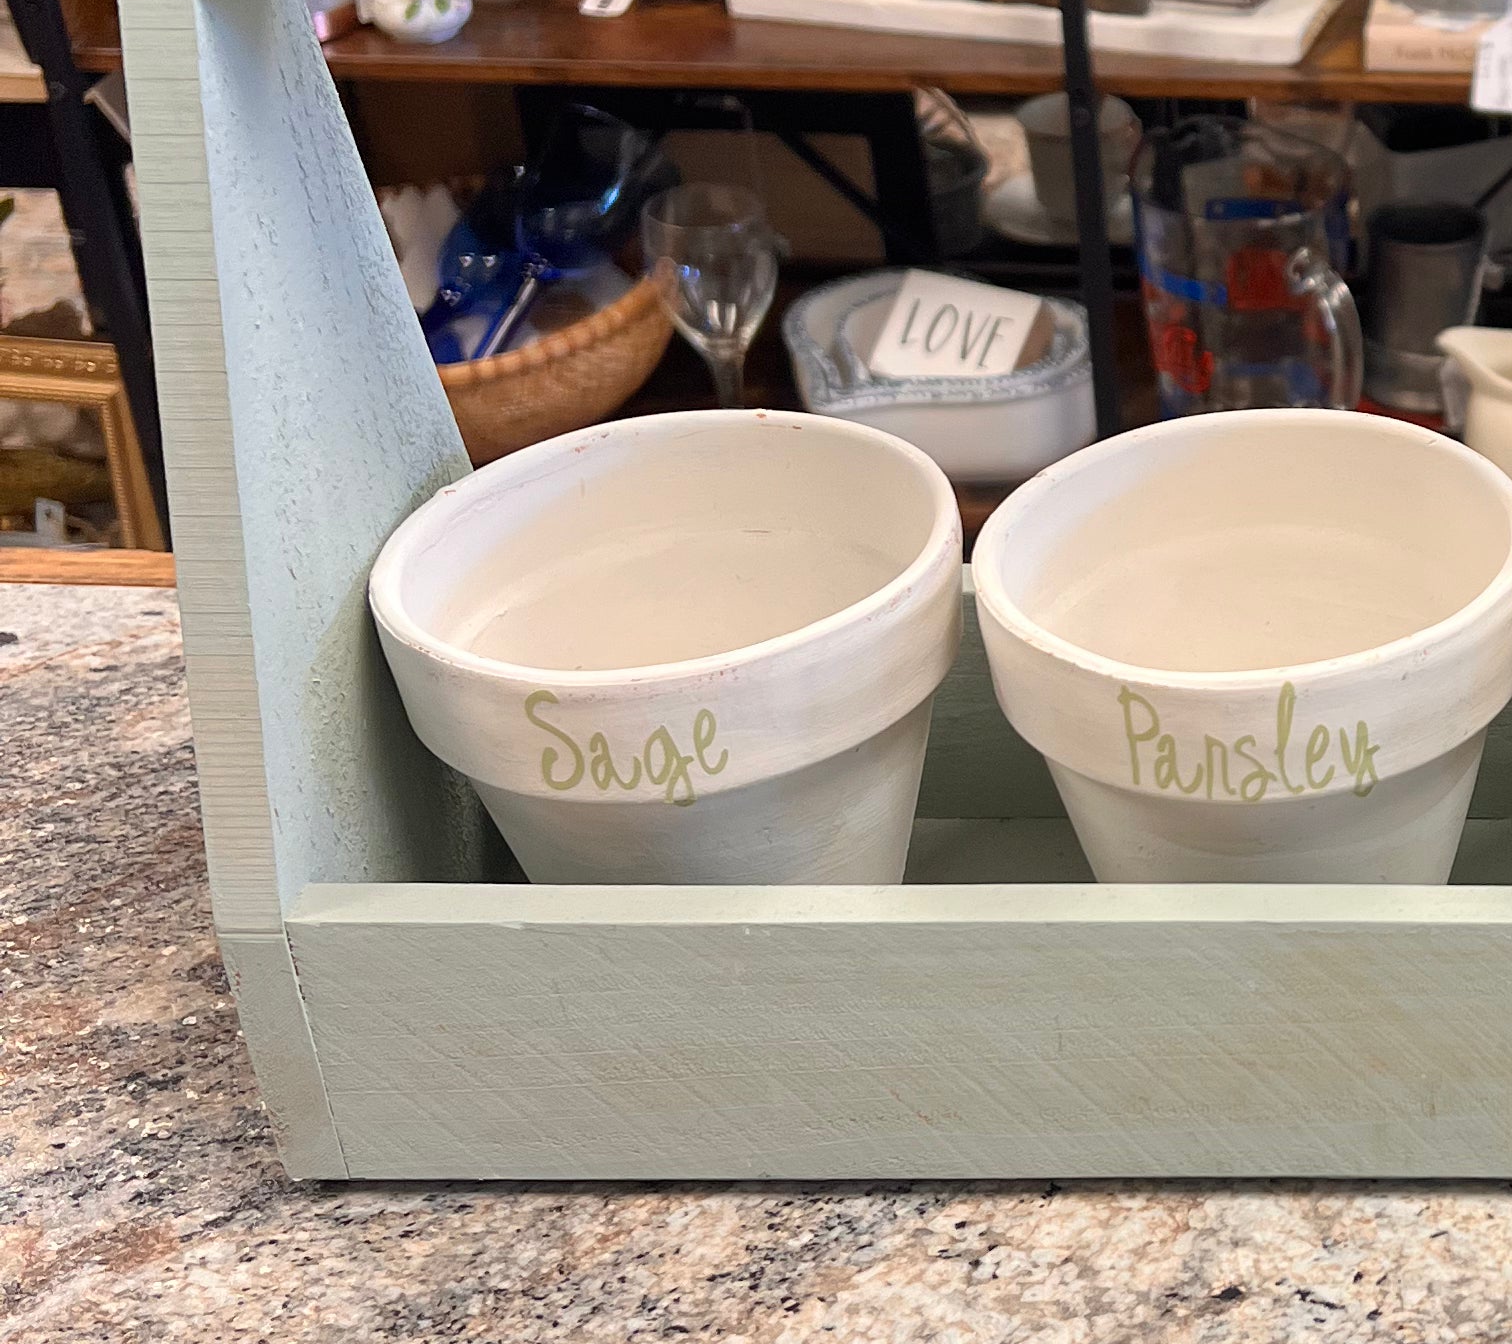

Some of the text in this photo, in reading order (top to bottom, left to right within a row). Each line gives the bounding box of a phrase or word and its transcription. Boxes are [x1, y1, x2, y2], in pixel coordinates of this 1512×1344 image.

[899, 296, 1016, 370] LOVE
[522, 688, 731, 809] Sage
[1116, 680, 1381, 804] Parsley
